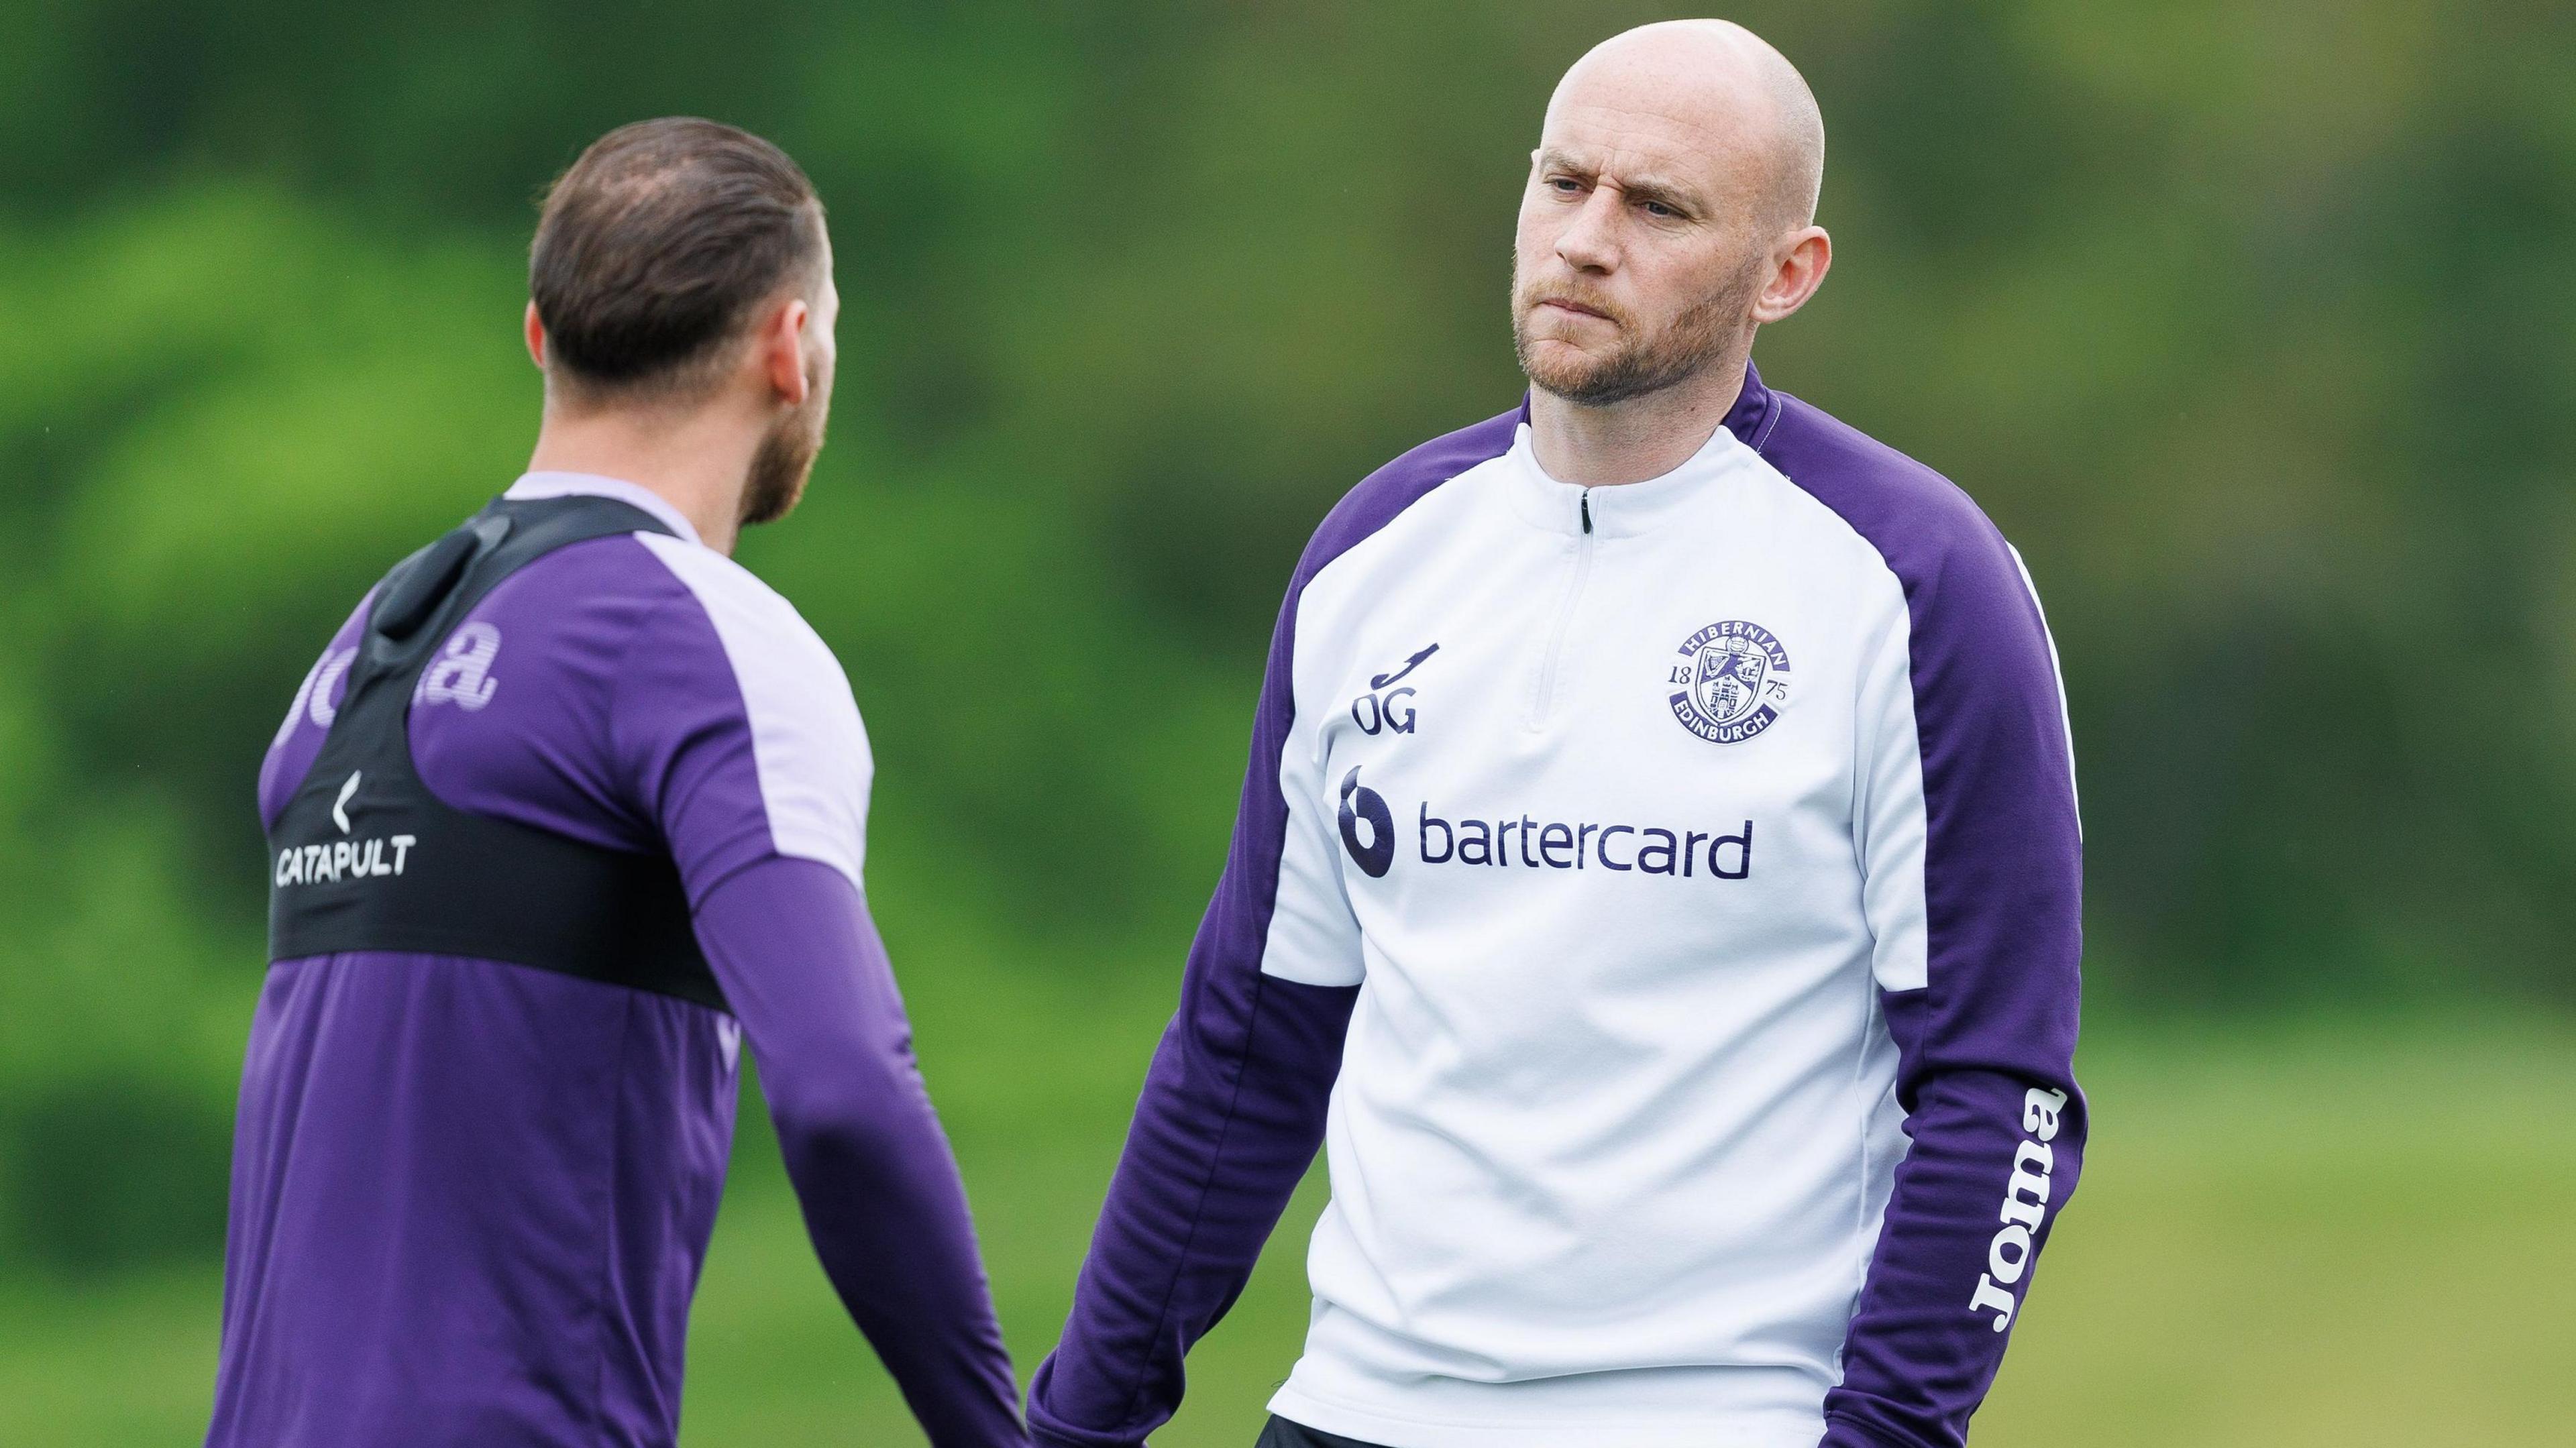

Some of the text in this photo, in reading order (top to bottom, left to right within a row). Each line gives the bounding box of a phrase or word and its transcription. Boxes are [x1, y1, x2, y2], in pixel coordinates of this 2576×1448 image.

[1684, 621, 1786, 666] HIBERNIAN
[274, 620, 502, 747] oa
[1668, 666, 1788, 700] 18 75
[1351, 687, 1417, 736] OG
[1674, 699, 1769, 742] EDINBURGH
[276, 834, 417, 888] CATAPULT
[1419, 801, 1754, 881] bartercard
[1968, 1087, 2068, 1333] Joma
